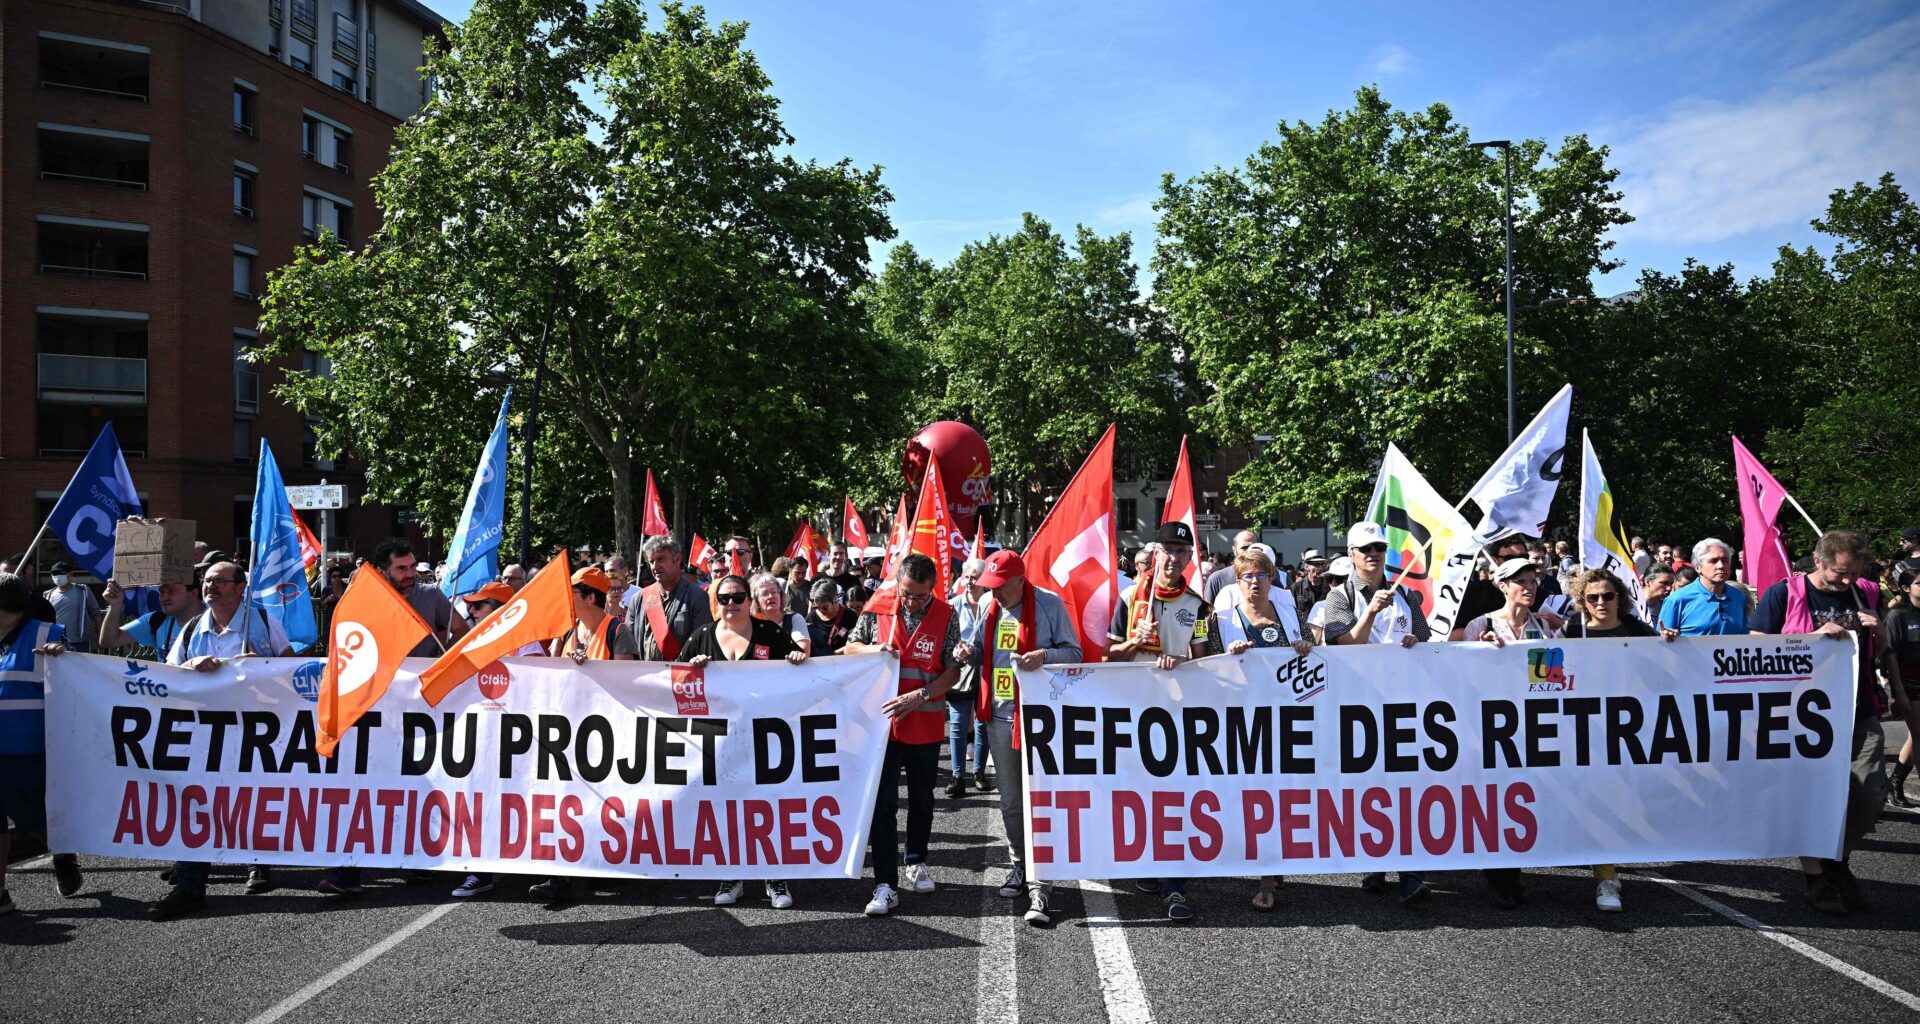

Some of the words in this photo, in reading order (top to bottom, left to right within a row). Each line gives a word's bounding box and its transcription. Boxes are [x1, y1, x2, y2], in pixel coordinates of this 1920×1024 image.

[961, 475, 990, 500] cg
[1177, 527, 1187, 538] FO
[915, 640, 935, 653] cgt
[1000, 632, 1017, 649] FO
[1276, 655, 1308, 684] CFE
[1713, 647, 1813, 677] Solidaires
[125, 676, 169, 698] cftc
[672, 677, 704, 699] cgt
[997, 674, 1011, 691] FO
[1292, 663, 1325, 694] CGC
[111, 705, 382, 775] RETRAT
[401, 712, 477, 779] DU
[499, 713, 728, 786] PROJET
[752, 713, 840, 785] DE
[1022, 704, 1316, 778] REFORME
[1340, 700, 1459, 774] DES
[1481, 688, 1834, 770] RETRAITES
[112, 780, 483, 858] AUGMENTATION
[500, 792, 585, 863] DES
[600, 795, 843, 866] SALAIRES
[1029, 790, 1091, 864] ET
[1111, 789, 1224, 862] DES
[1242, 781, 1538, 861] PENSIONS
